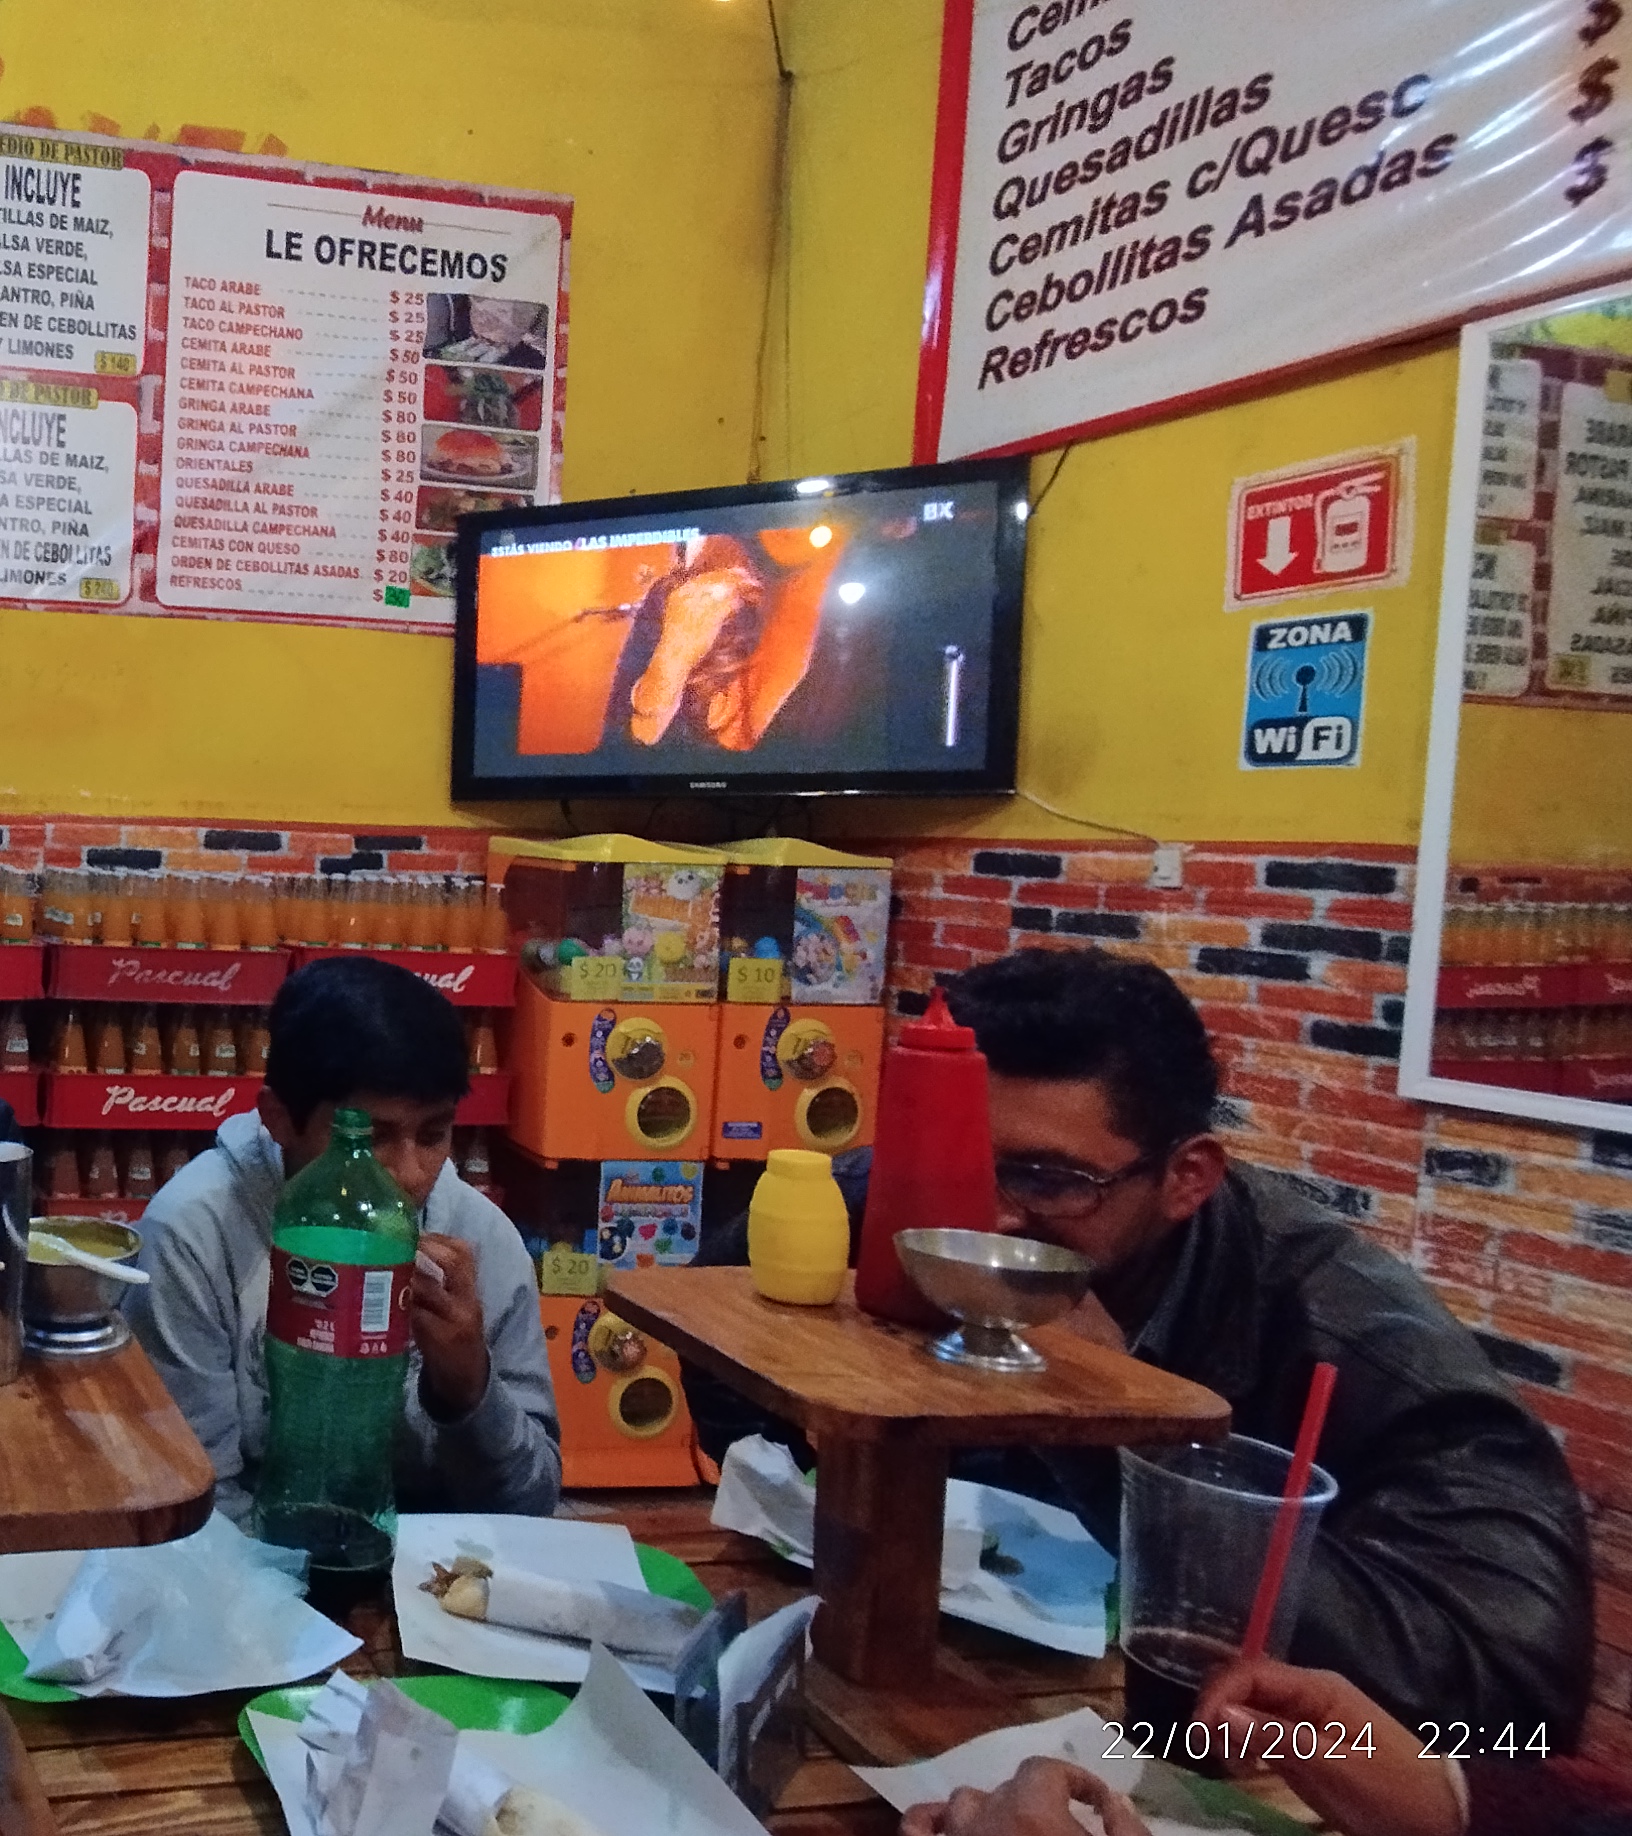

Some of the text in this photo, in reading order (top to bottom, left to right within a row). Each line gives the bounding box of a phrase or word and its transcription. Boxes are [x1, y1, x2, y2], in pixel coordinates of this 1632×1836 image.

[1005, 18, 1133, 109] Tacos
[997, 56, 1176, 164] Gringas
[993, 71, 1274, 222] Quesadillas
[5, 165, 81, 208] INCLUYE
[361, 205, 424, 233] Menu
[985, 132, 1458, 333] Cebollitas Asadas
[989, 180, 1172, 277] Cemitas
[36, 237, 87, 260] VERDE,
[266, 229, 508, 283] LE OFRECEMOS
[27, 262, 98, 285] ESPECIAL
[60, 292, 94, 310] PIÑA
[184, 276, 424, 305] TACO ARABE $ 25
[183, 317, 424, 343] TACO CAMPECHANO $ 25
[978, 285, 1209, 391] Refrescos
[182, 337, 419, 364] CEMITA ARABE $ 50
[176, 456, 414, 483] ORIENTALES $ 25
[1248, 493, 1313, 519] EXTINTOR
[172, 536, 408, 563] CEMITAS CON QUESO $ 80
[527, 540, 572, 553] VIENDO
[171, 556, 407, 583] ORDEN DE CEBOLLITAS ASADAS $ 20
[170, 575, 382, 601] REFRESCOS $
[1268, 620, 1353, 651] ZONA
[108, 957, 242, 993] Pascual
[579, 961, 616, 981] $ 20
[737, 967, 775, 983] $ 10
[101, 1085, 236, 1119] Pascual
[552, 1258, 589, 1275] $ 20
